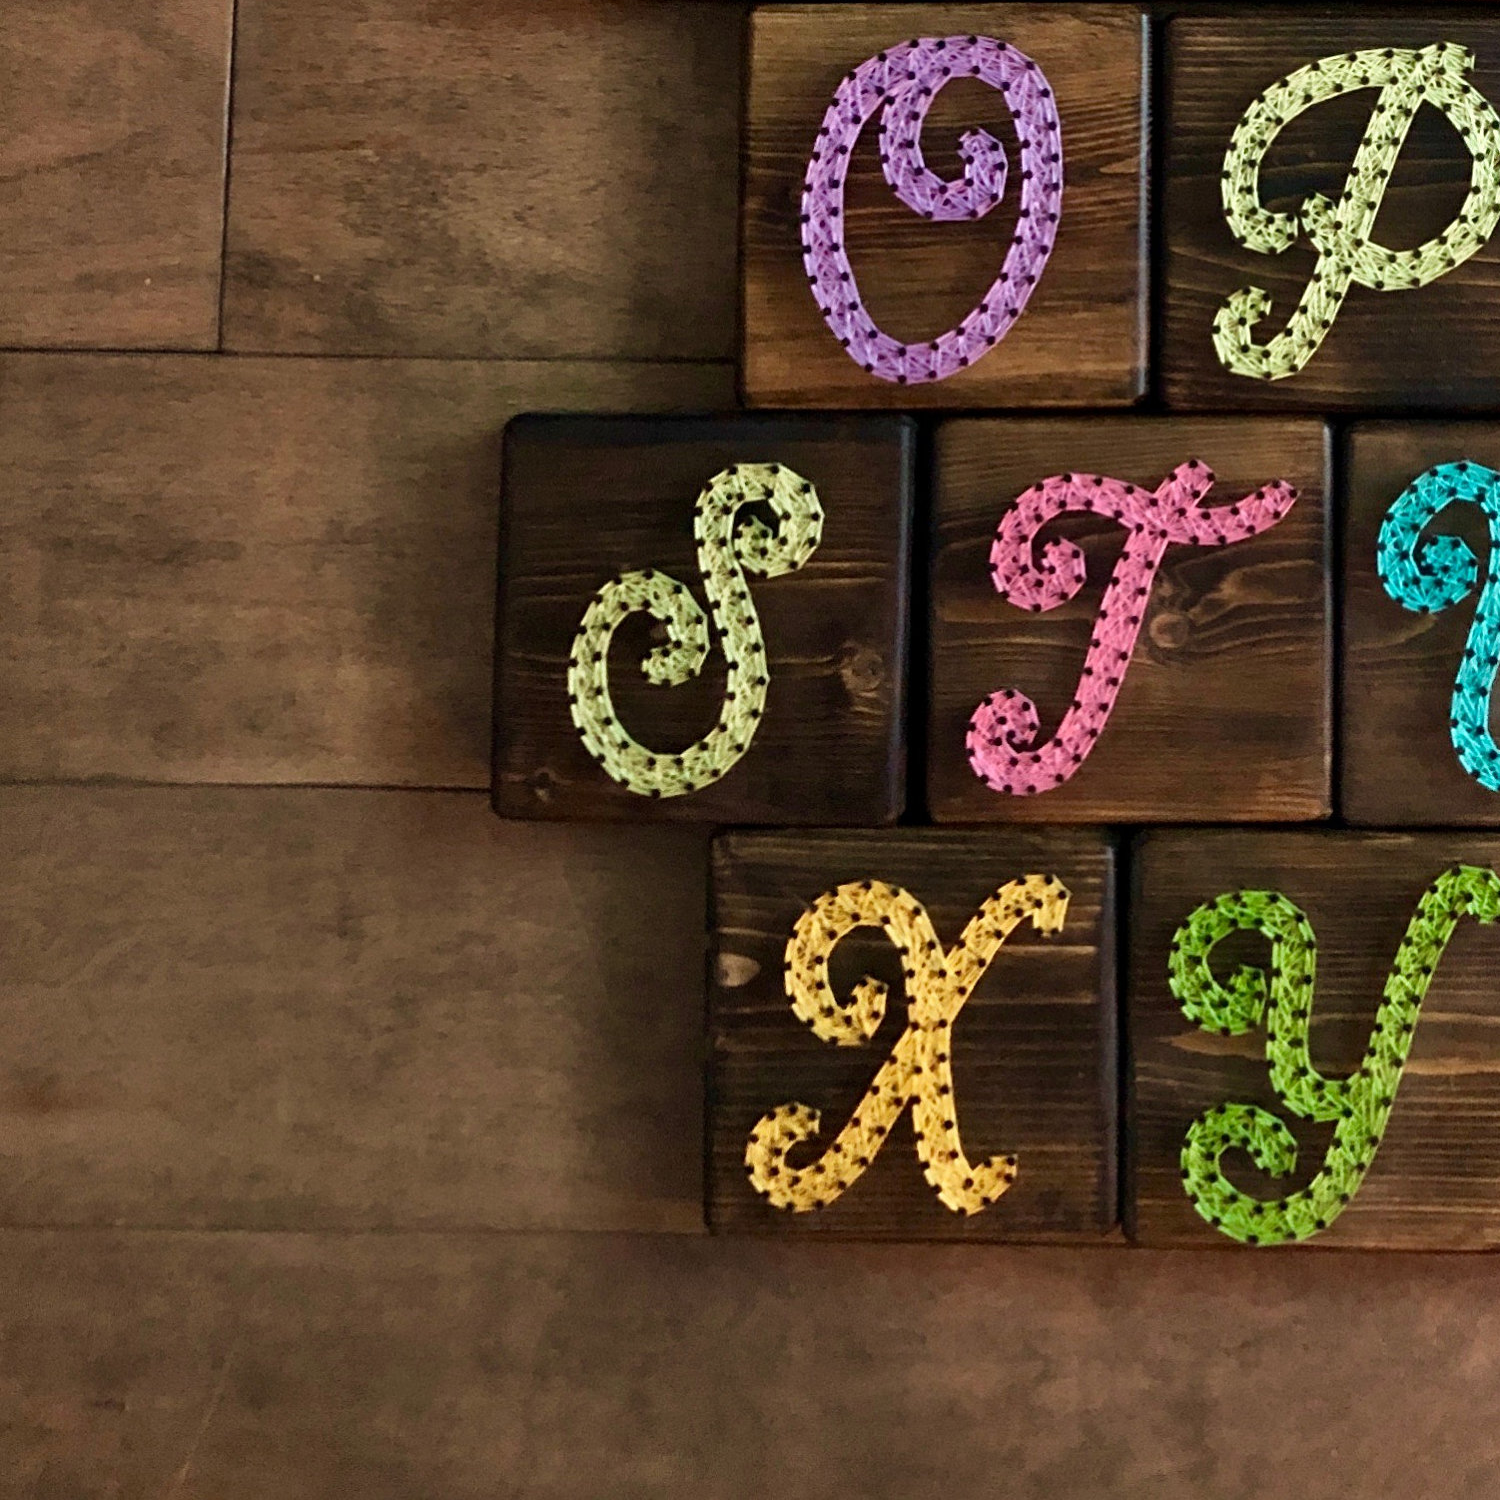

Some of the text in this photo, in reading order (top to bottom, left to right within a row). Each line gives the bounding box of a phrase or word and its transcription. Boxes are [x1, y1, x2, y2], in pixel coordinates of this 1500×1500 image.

[801, 36, 1063, 384] O
[568, 464, 824, 797] S
[966, 462, 1295, 795] T
[746, 875, 1068, 1214] X
